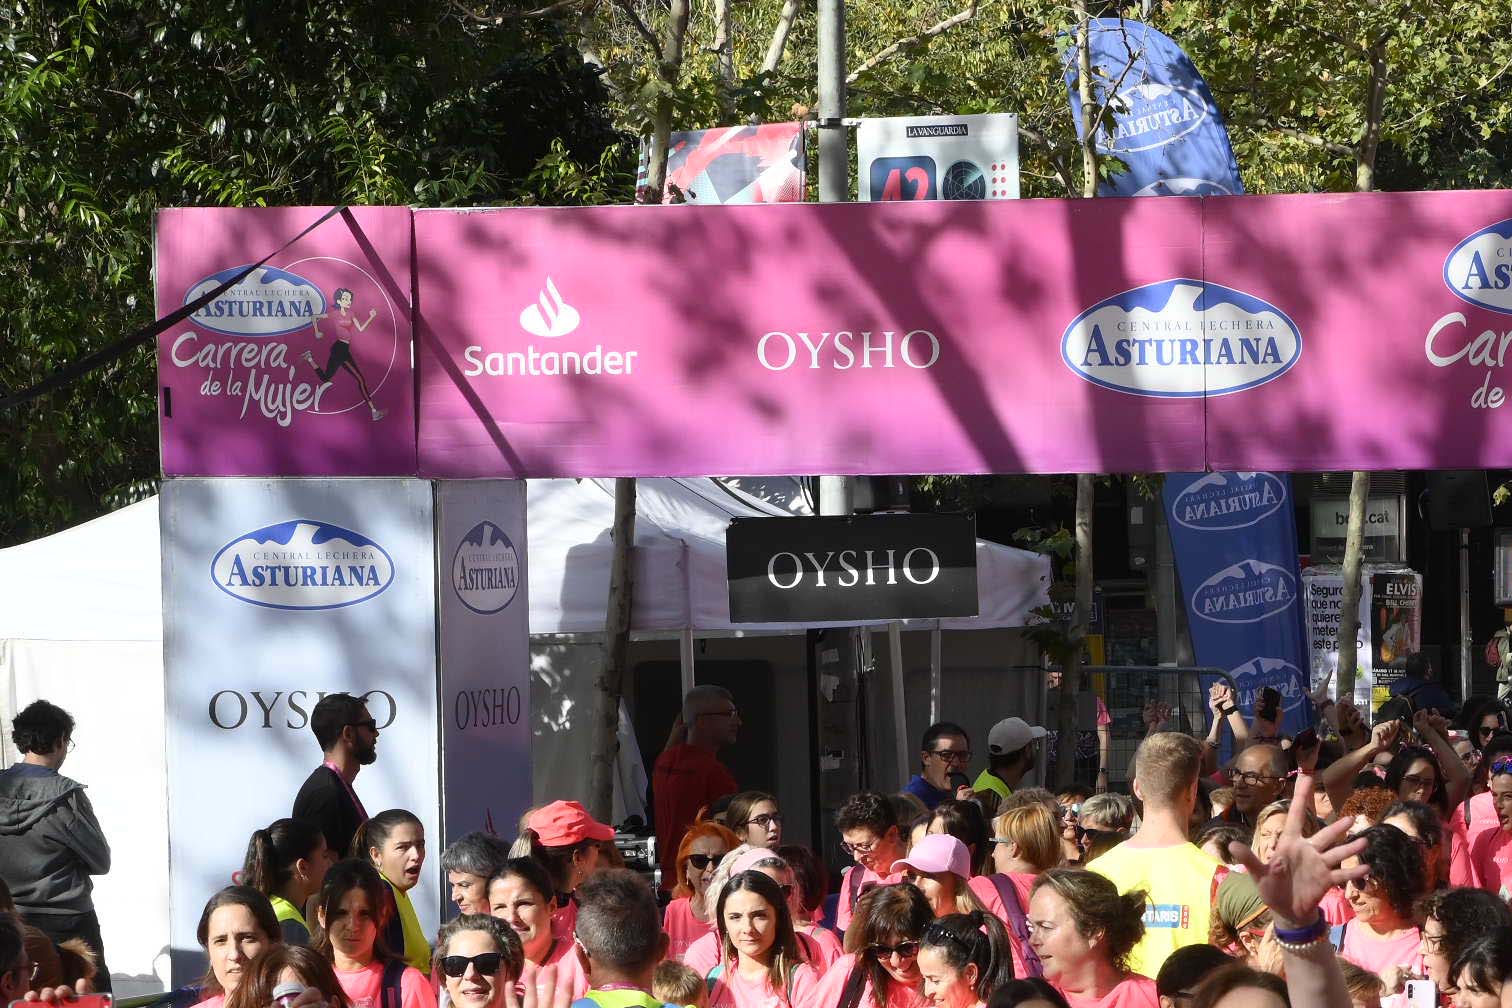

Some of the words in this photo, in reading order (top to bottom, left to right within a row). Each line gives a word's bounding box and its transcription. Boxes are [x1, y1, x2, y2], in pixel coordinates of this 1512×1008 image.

[1117, 320, 1192, 332] CENTRAL
[1200, 320, 1275, 331] LECHERA
[171, 332, 290, 369] Carrera
[465, 345, 638, 377] Santander
[757, 330, 940, 371] OYSHO
[1080, 323, 1283, 367] ASTURIANA
[201, 371, 222, 396] de
[226, 369, 242, 396] la
[240, 365, 333, 428] Mujer
[1471, 376, 1505, 409] de
[226, 554, 381, 587] ASTURIANA
[253, 552, 312, 560] CENTRAL
[317, 551, 375, 560] LECHERA
[767, 547, 940, 589] OYSHO
[458, 556, 516, 592] ASTURIANA
[1386, 582, 1417, 596] ELVIS
[208, 690, 397, 730] OYSO
[455, 686, 521, 730] OYSHO
